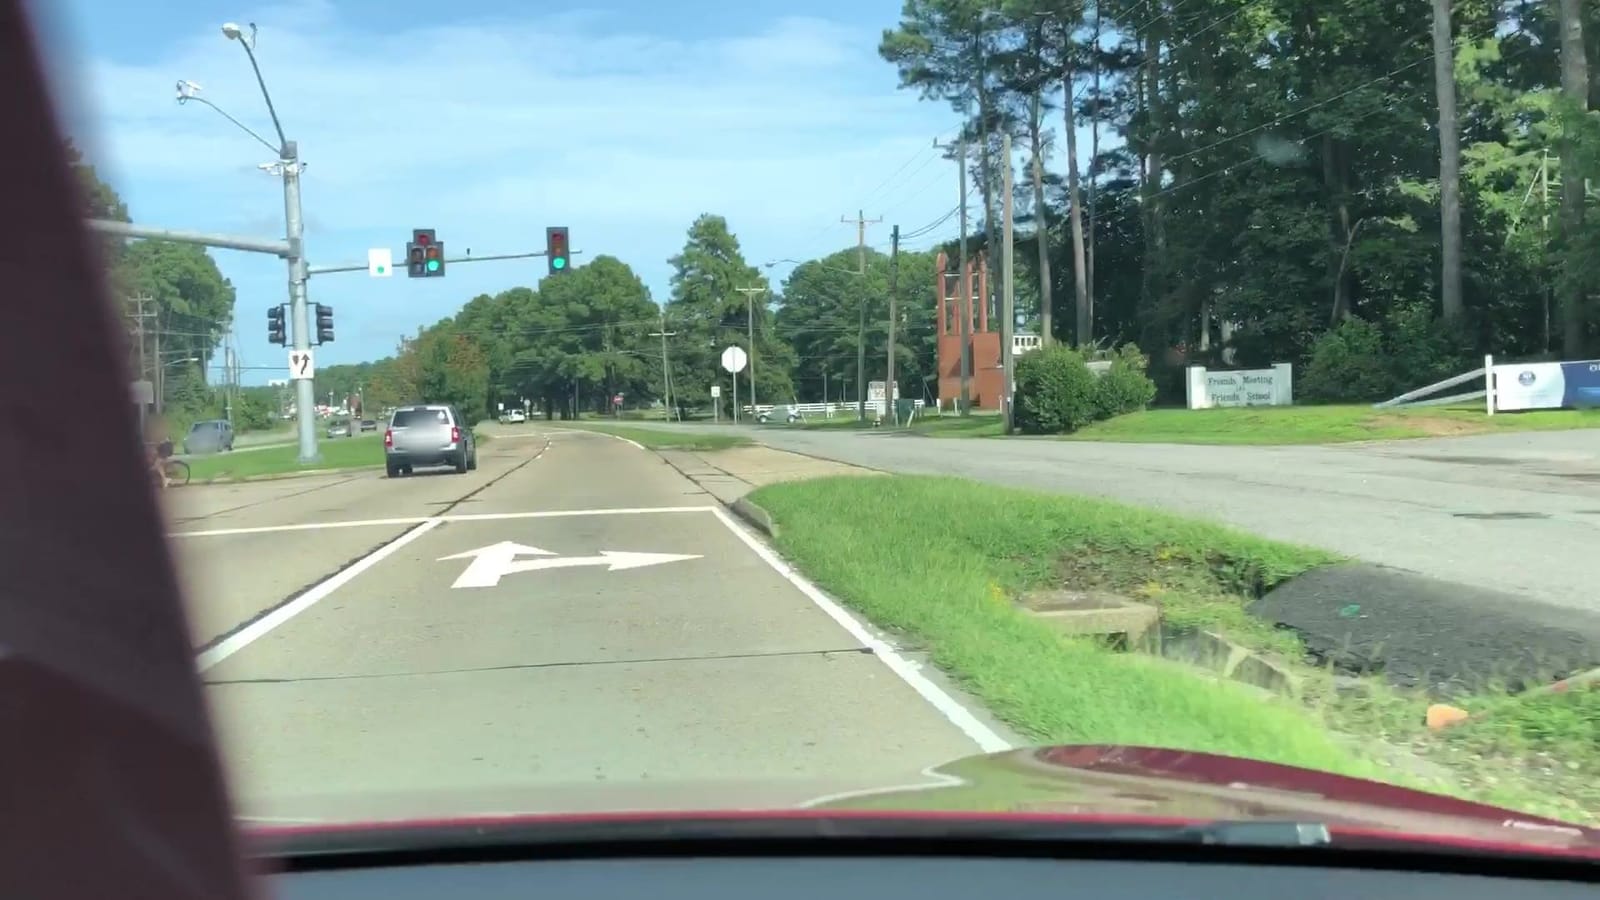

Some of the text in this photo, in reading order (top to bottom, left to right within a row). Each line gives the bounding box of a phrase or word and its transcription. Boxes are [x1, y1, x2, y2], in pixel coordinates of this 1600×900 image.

[1242, 375, 1273, 385] Meeting
[1211, 391, 1271, 401] Friends School
